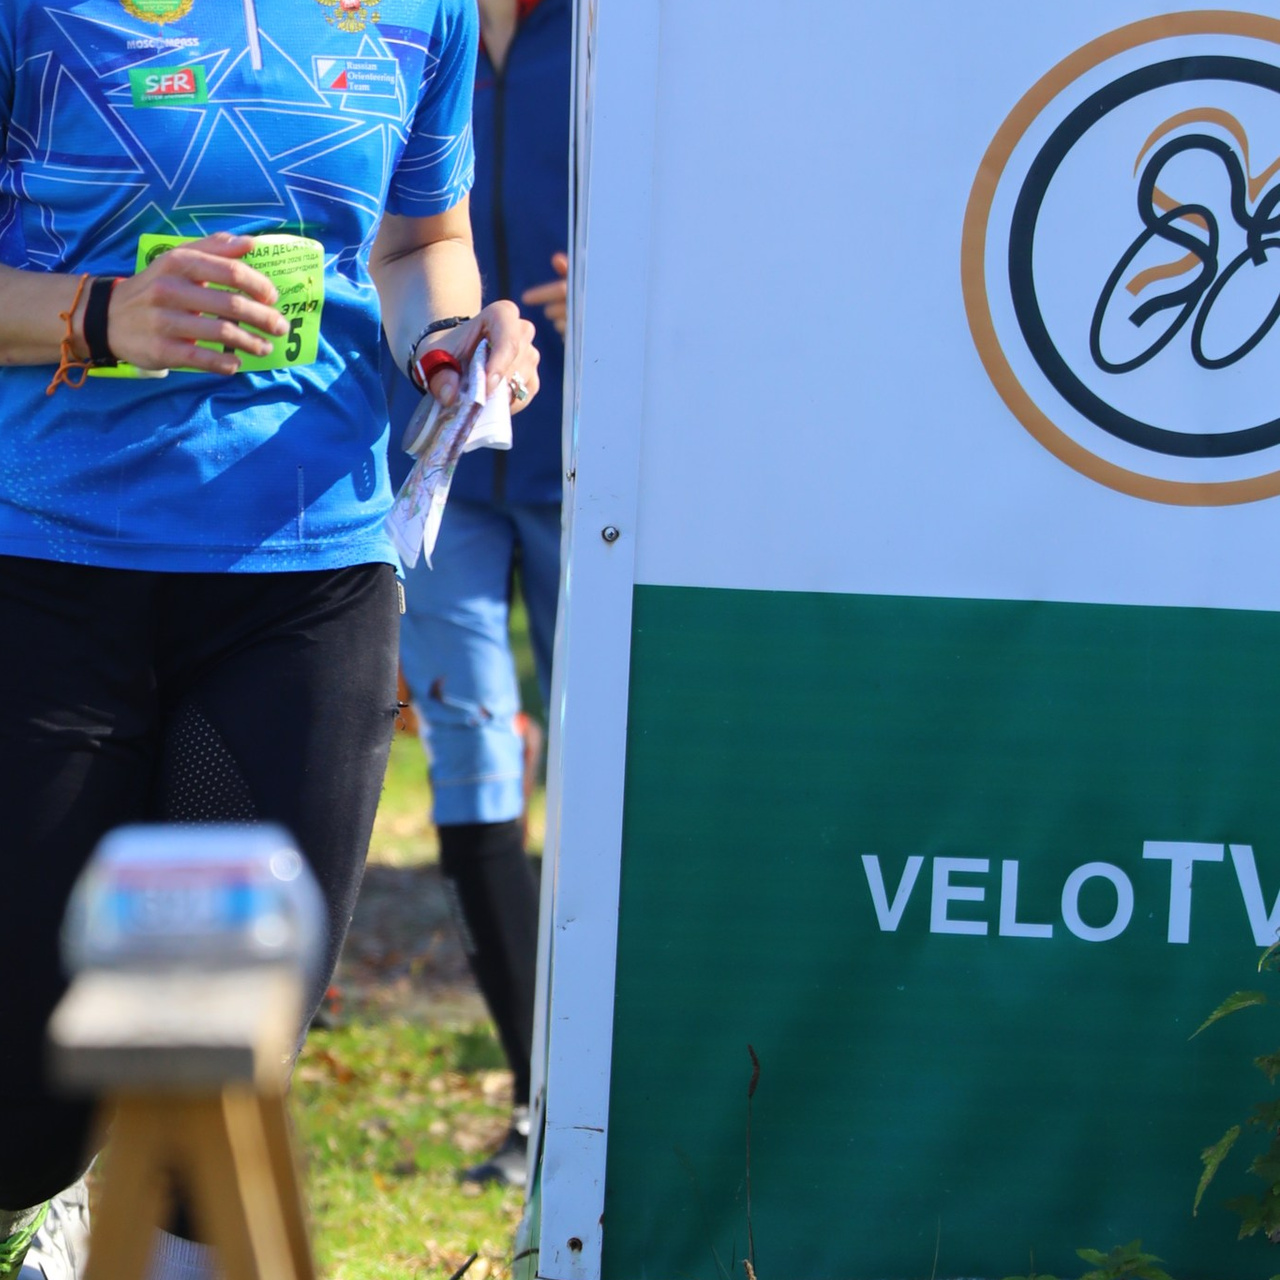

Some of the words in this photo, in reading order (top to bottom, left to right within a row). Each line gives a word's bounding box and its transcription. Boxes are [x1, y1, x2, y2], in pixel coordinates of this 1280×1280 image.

[346, 61, 378, 71] Russian
[145, 73, 191, 93] SFR
[346, 72, 396, 85] Orienteering
[348, 82, 370, 91] Team
[281, 299, 319, 316] ЭТАП
[285, 317, 303, 362] 5
